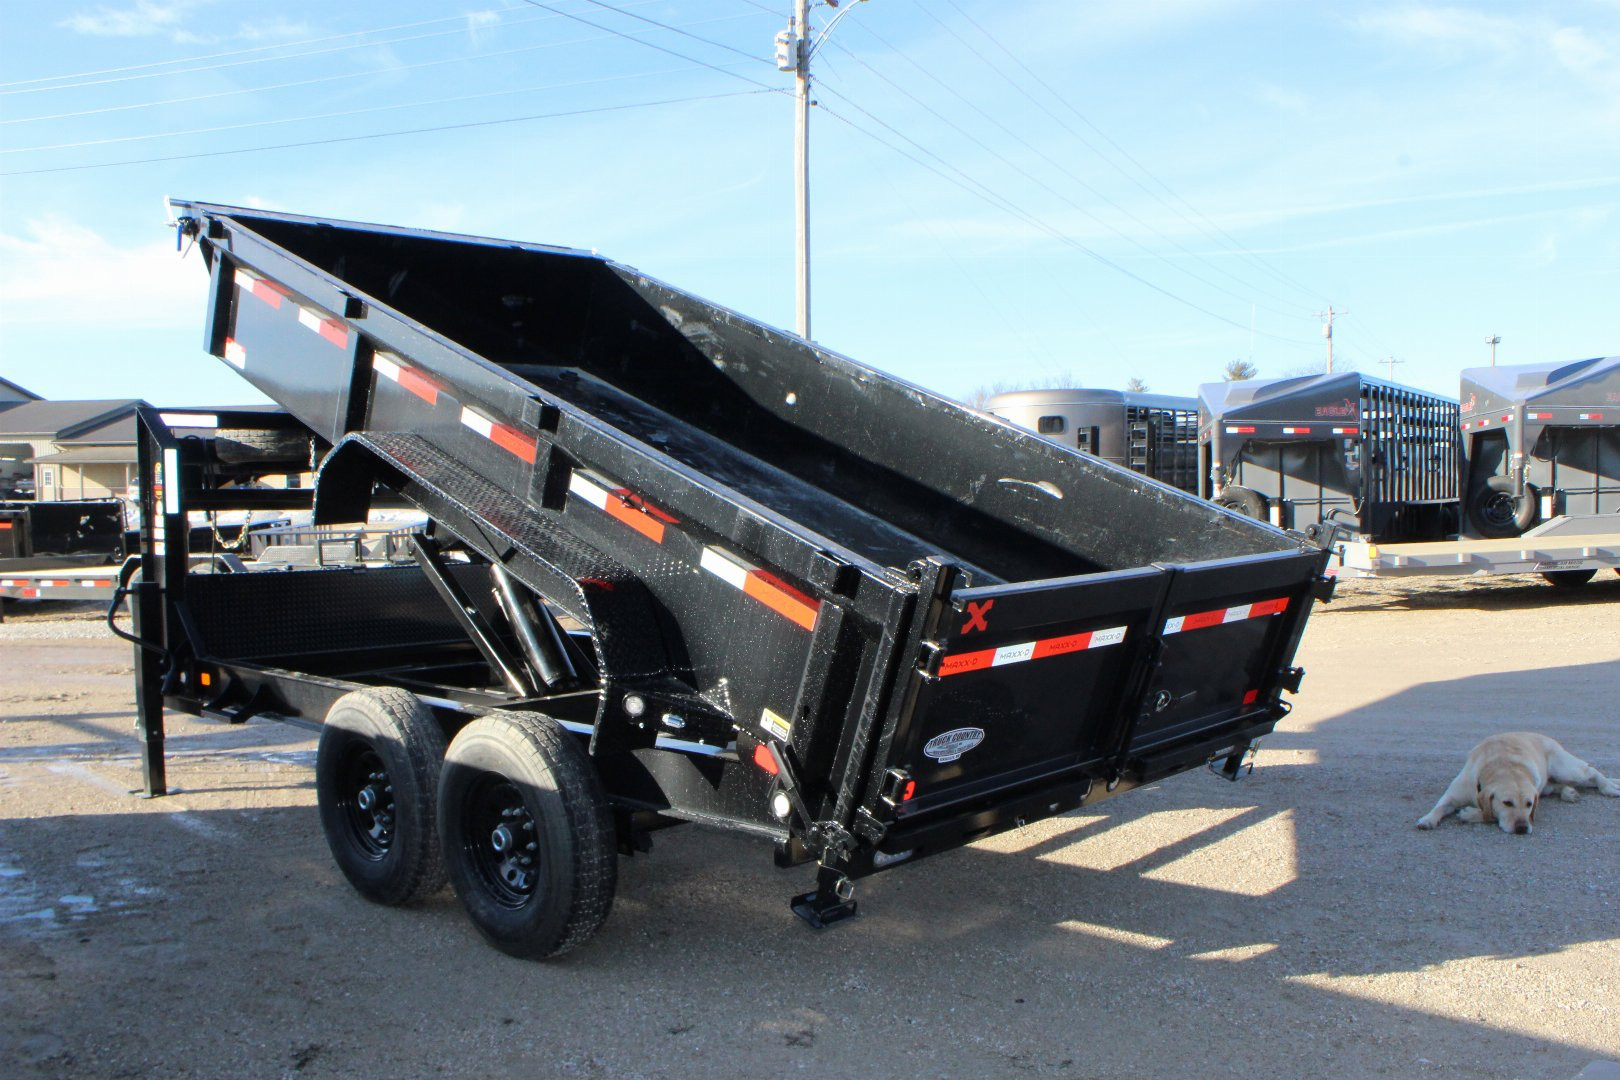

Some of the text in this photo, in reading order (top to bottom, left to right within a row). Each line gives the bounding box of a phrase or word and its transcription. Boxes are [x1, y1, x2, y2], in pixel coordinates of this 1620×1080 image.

[945, 632, 1121, 669] MAXX-D MAXX-D MAXX-D MAXX-D
[929, 731, 980, 747] TRUCK COUNTRY
